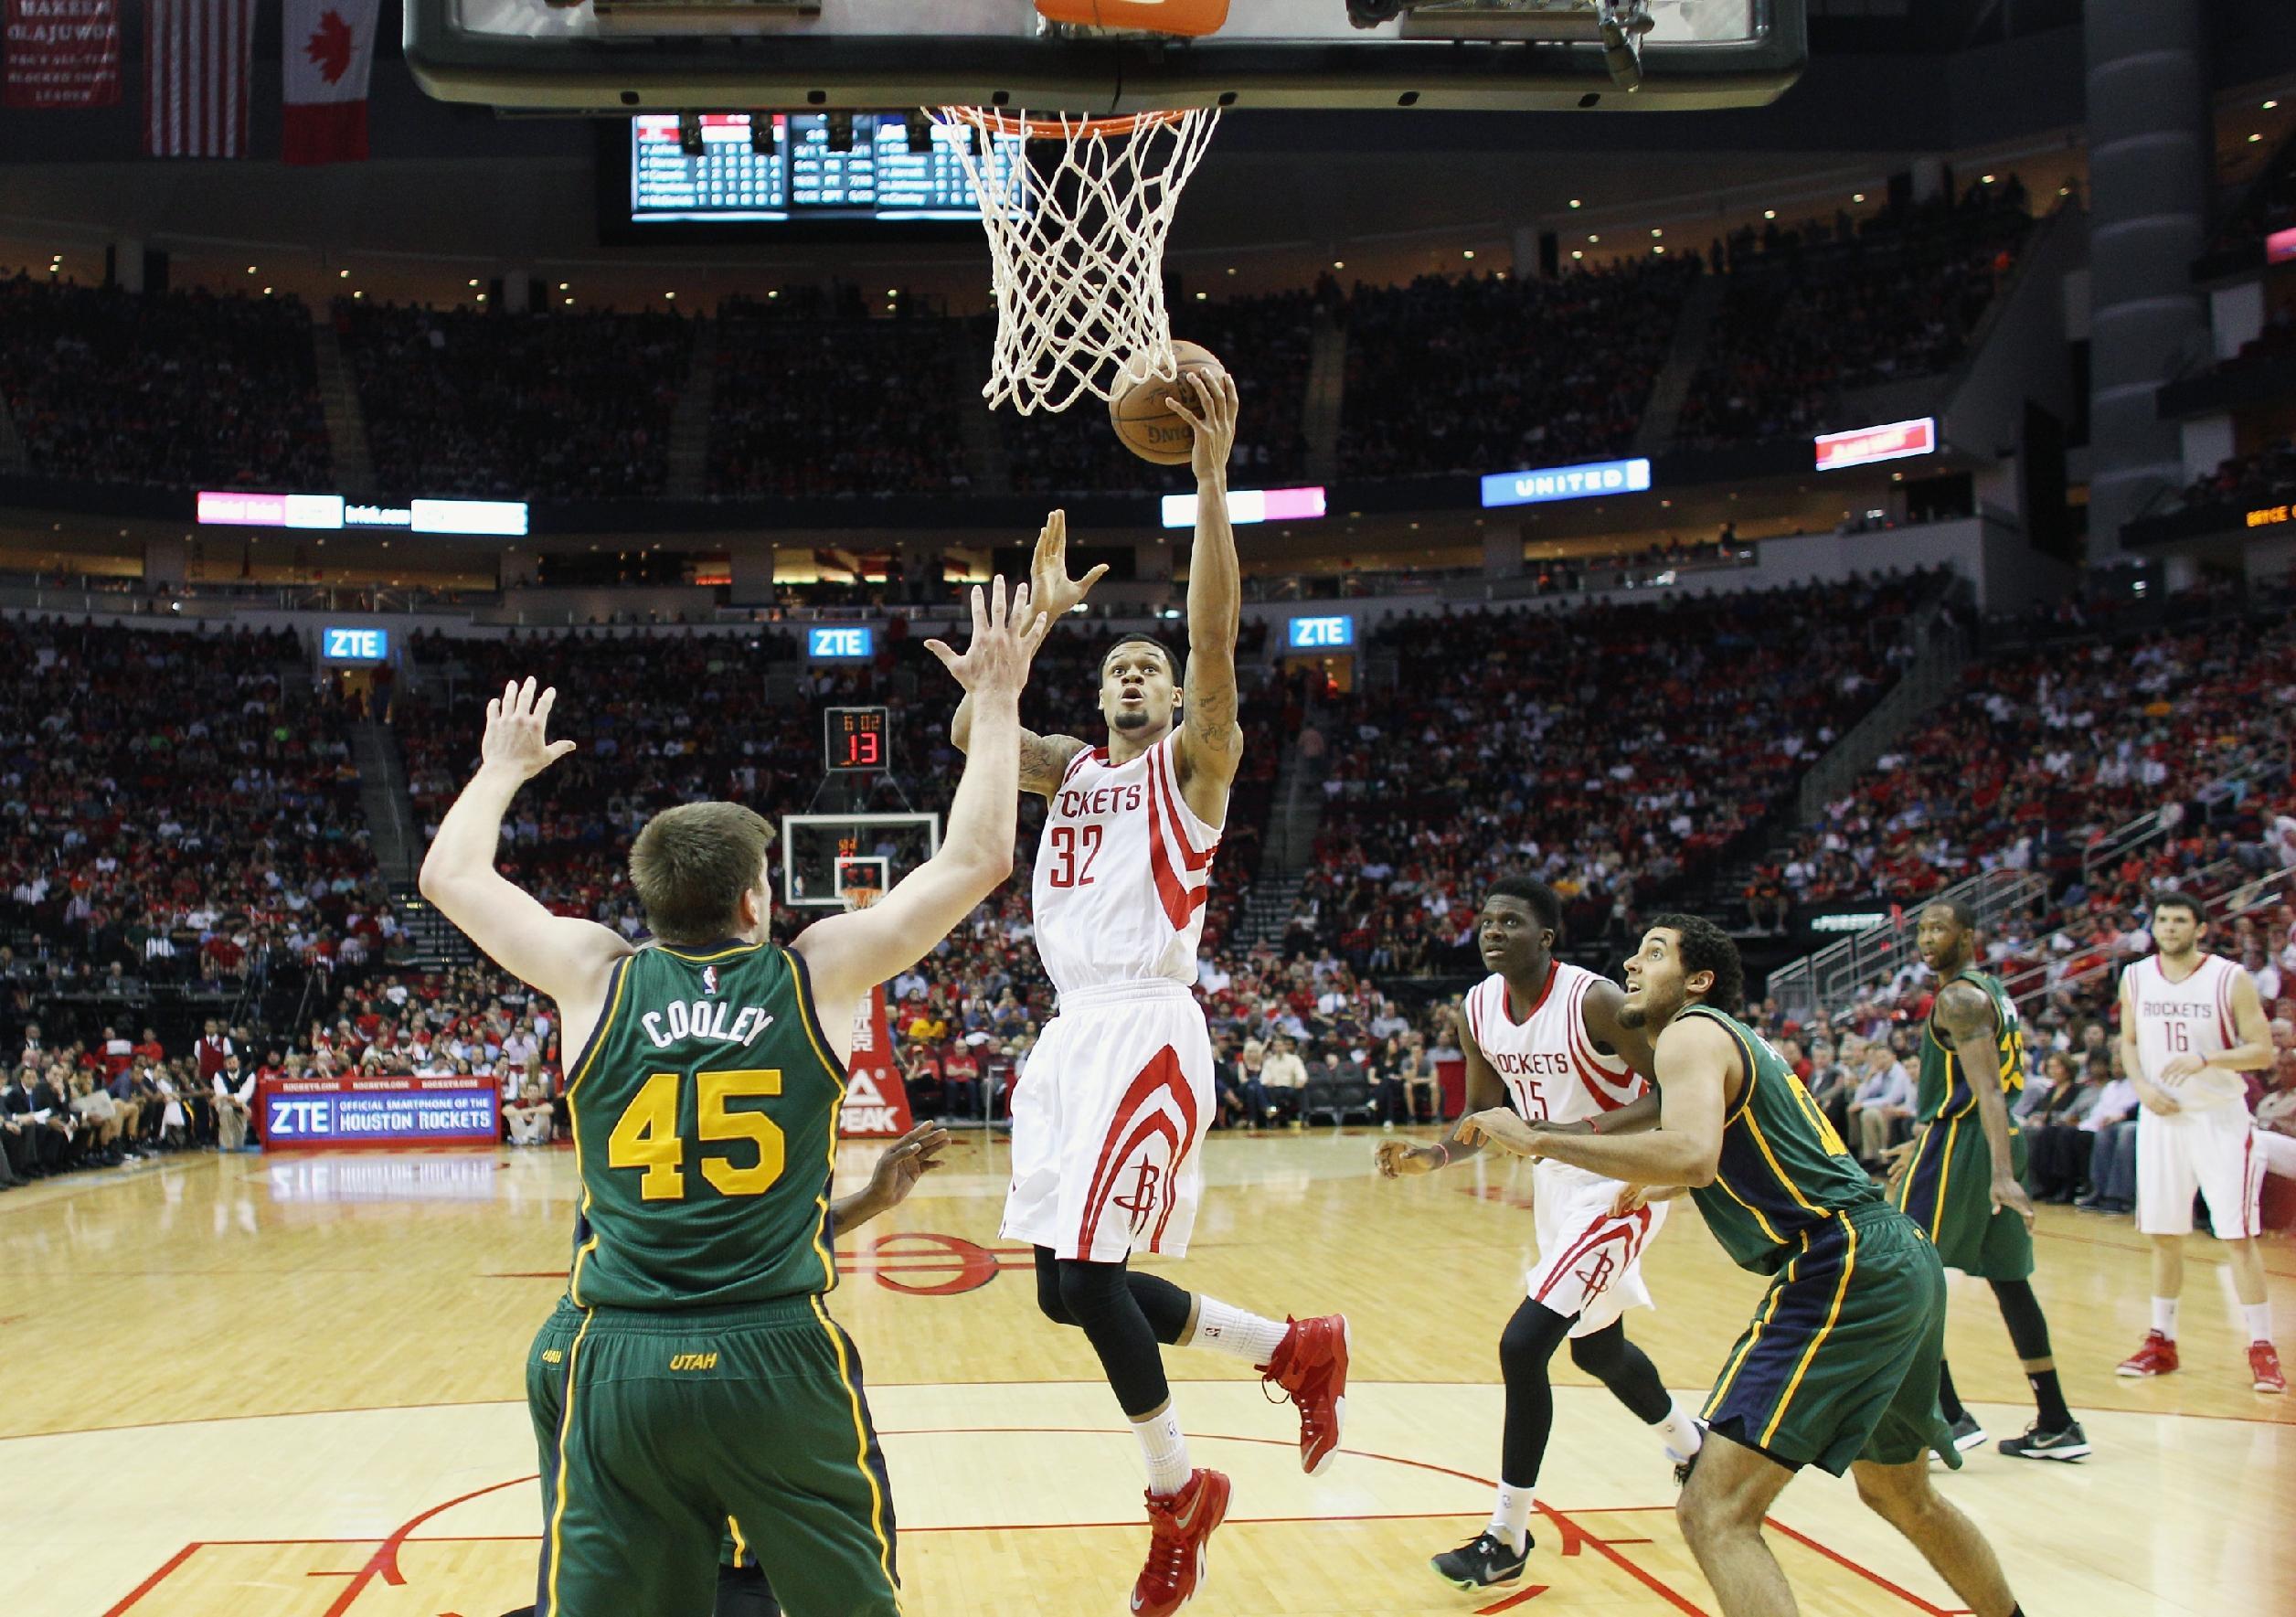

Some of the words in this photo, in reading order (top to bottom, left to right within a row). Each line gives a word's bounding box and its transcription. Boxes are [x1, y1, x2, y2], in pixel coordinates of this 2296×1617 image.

[1515, 469, 1623, 497] UNITED
[330, 629, 377, 656] ZTE
[815, 628, 863, 655] ZTE
[1296, 617, 1344, 646] ZTE
[849, 732, 877, 763] 13
[1058, 784, 1142, 818] CKETS
[1050, 824, 1103, 888] 32
[642, 1000, 774, 1048] COOLEY
[2143, 1001, 2213, 1018] ROCKETS
[2164, 1021, 2188, 1052] 16
[1497, 1053, 1568, 1075] OCKETS
[339, 1101, 383, 1112] OFFICIAL
[386, 1099, 453, 1111] SMARTPHONE
[454, 1099, 469, 1109] OF
[469, 1098, 489, 1109] THE
[1515, 1080, 1549, 1121] 15
[271, 1101, 331, 1133] ZTE
[340, 1112, 412, 1132] HOUSTON
[419, 1111, 491, 1130] ROCKETS
[609, 1069, 785, 1200] 45
[669, 1353, 718, 1371] UTAH
